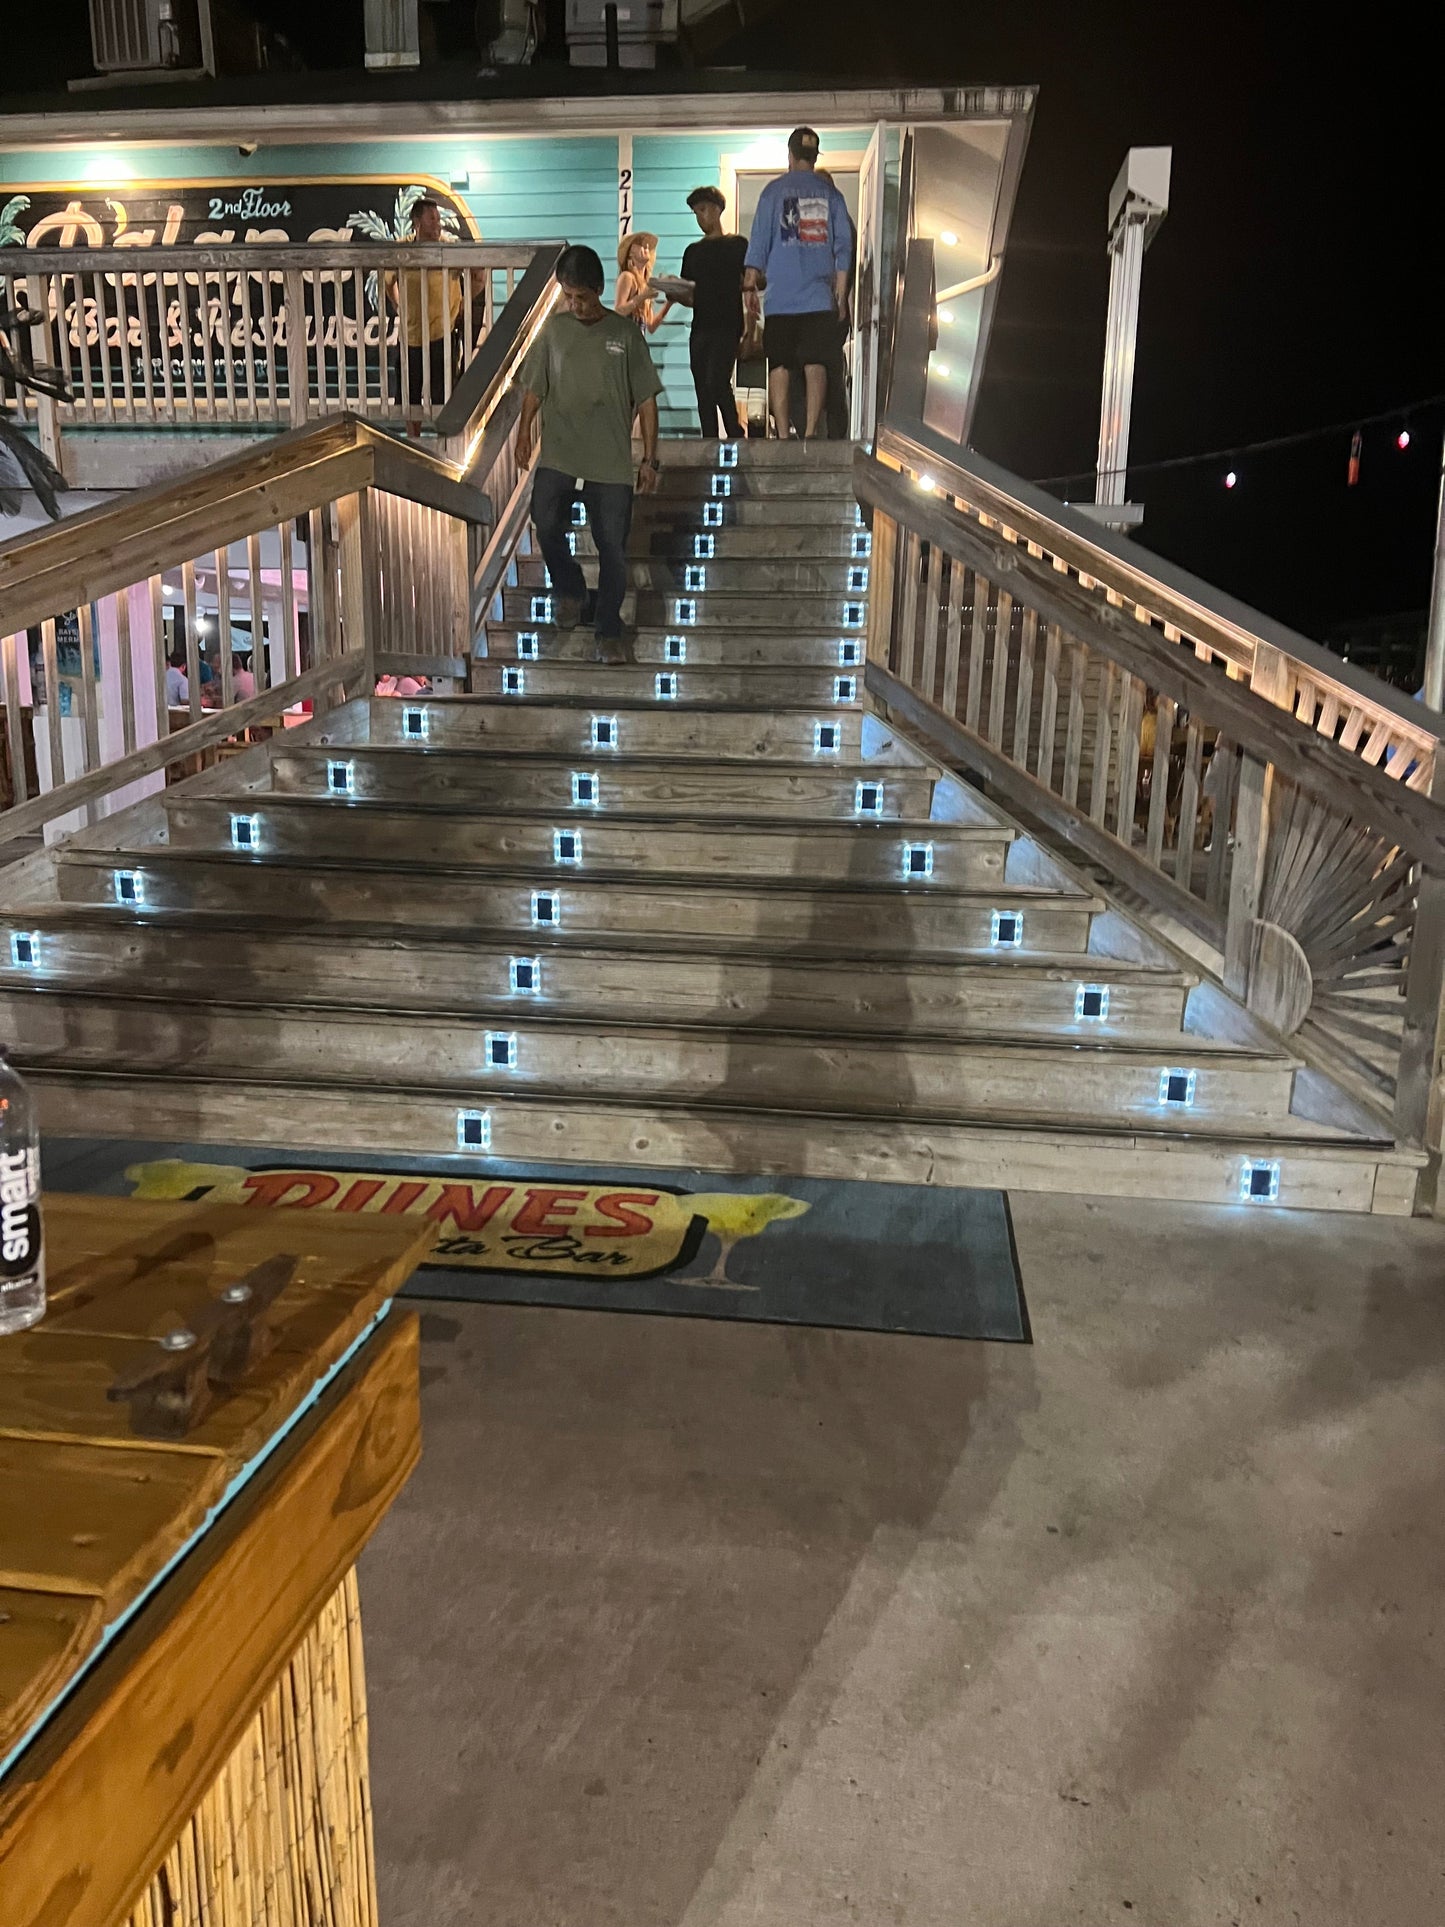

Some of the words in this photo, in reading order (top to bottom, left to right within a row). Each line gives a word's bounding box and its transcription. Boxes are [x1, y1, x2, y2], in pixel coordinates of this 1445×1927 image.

[208, 198, 242, 220] 2nd
[241, 187, 293, 220] Floor
[502, 1234, 634, 1266] Bar
